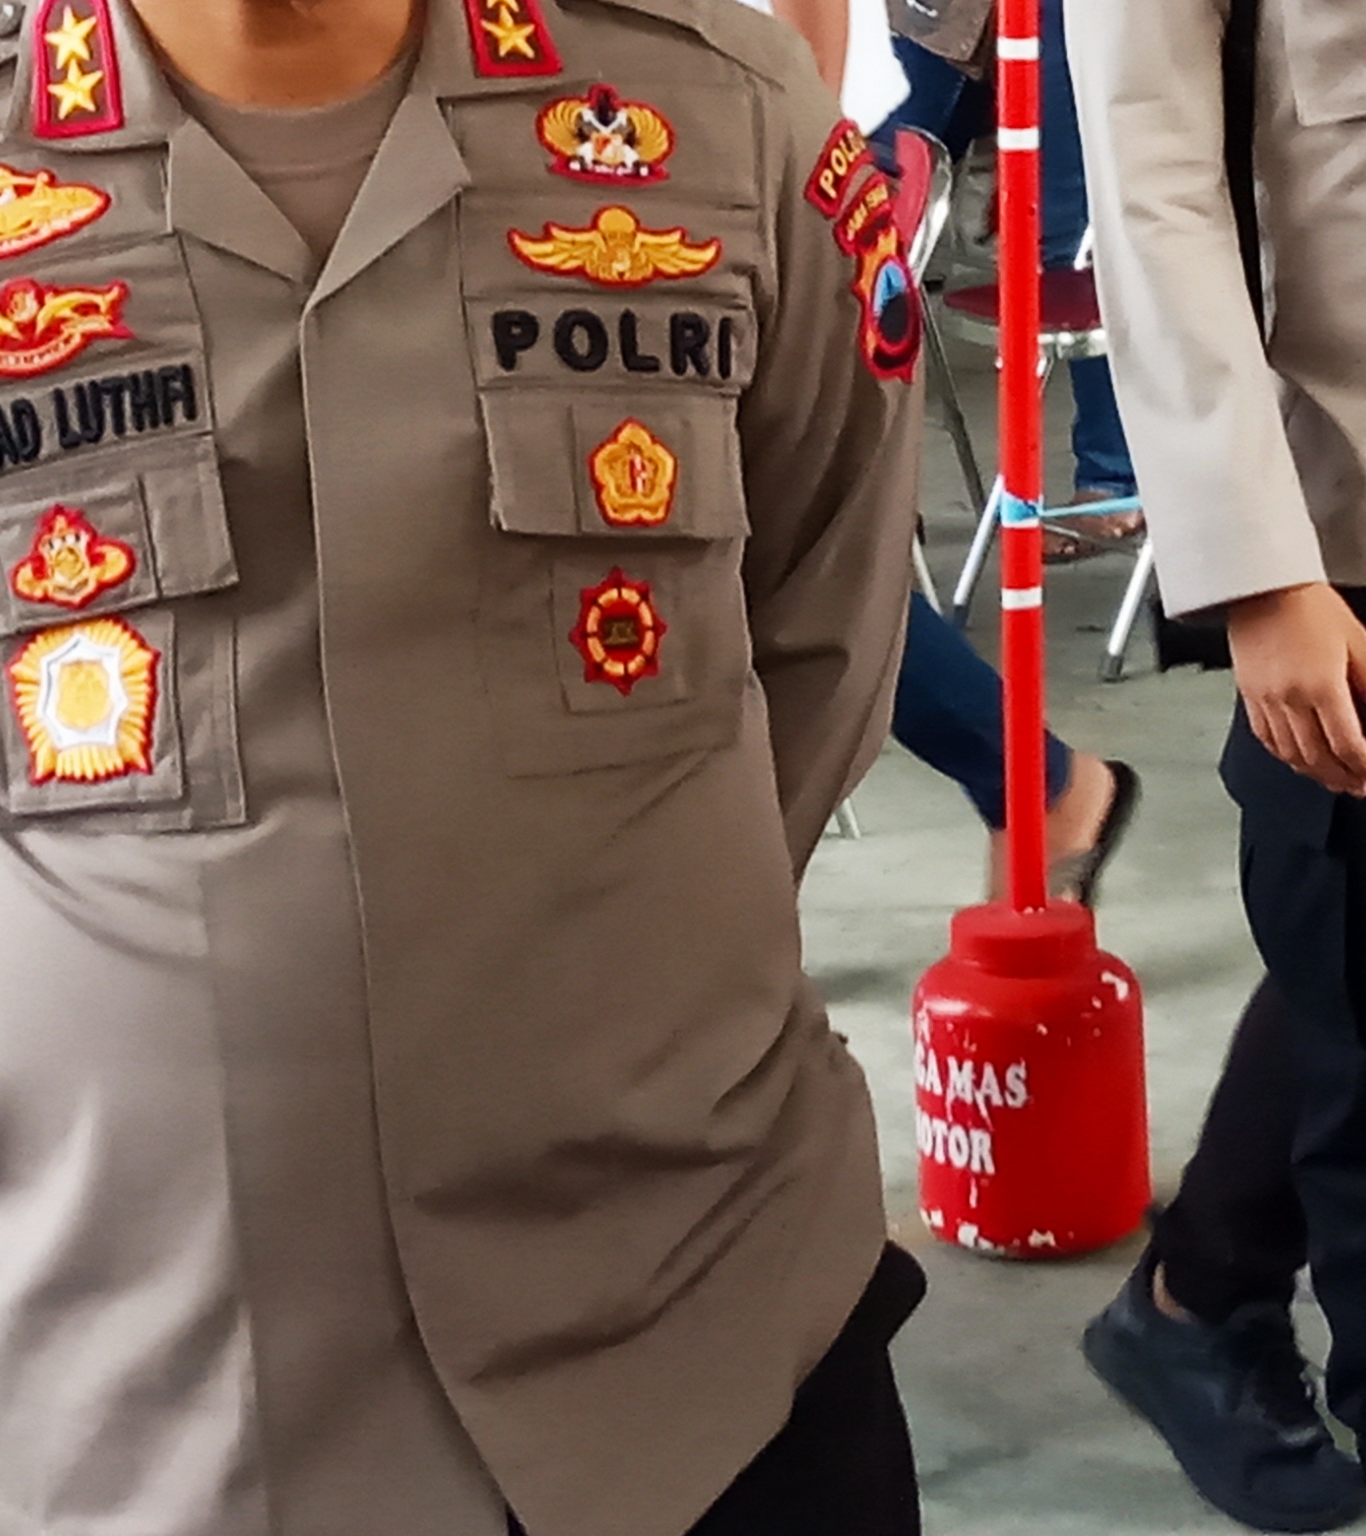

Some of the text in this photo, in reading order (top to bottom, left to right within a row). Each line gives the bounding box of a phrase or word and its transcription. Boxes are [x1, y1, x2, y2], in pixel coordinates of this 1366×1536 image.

[492, 309, 733, 380] POLRI
[53, 363, 196, 449] LUTHFI
[947, 1054, 1028, 1109] MAS
